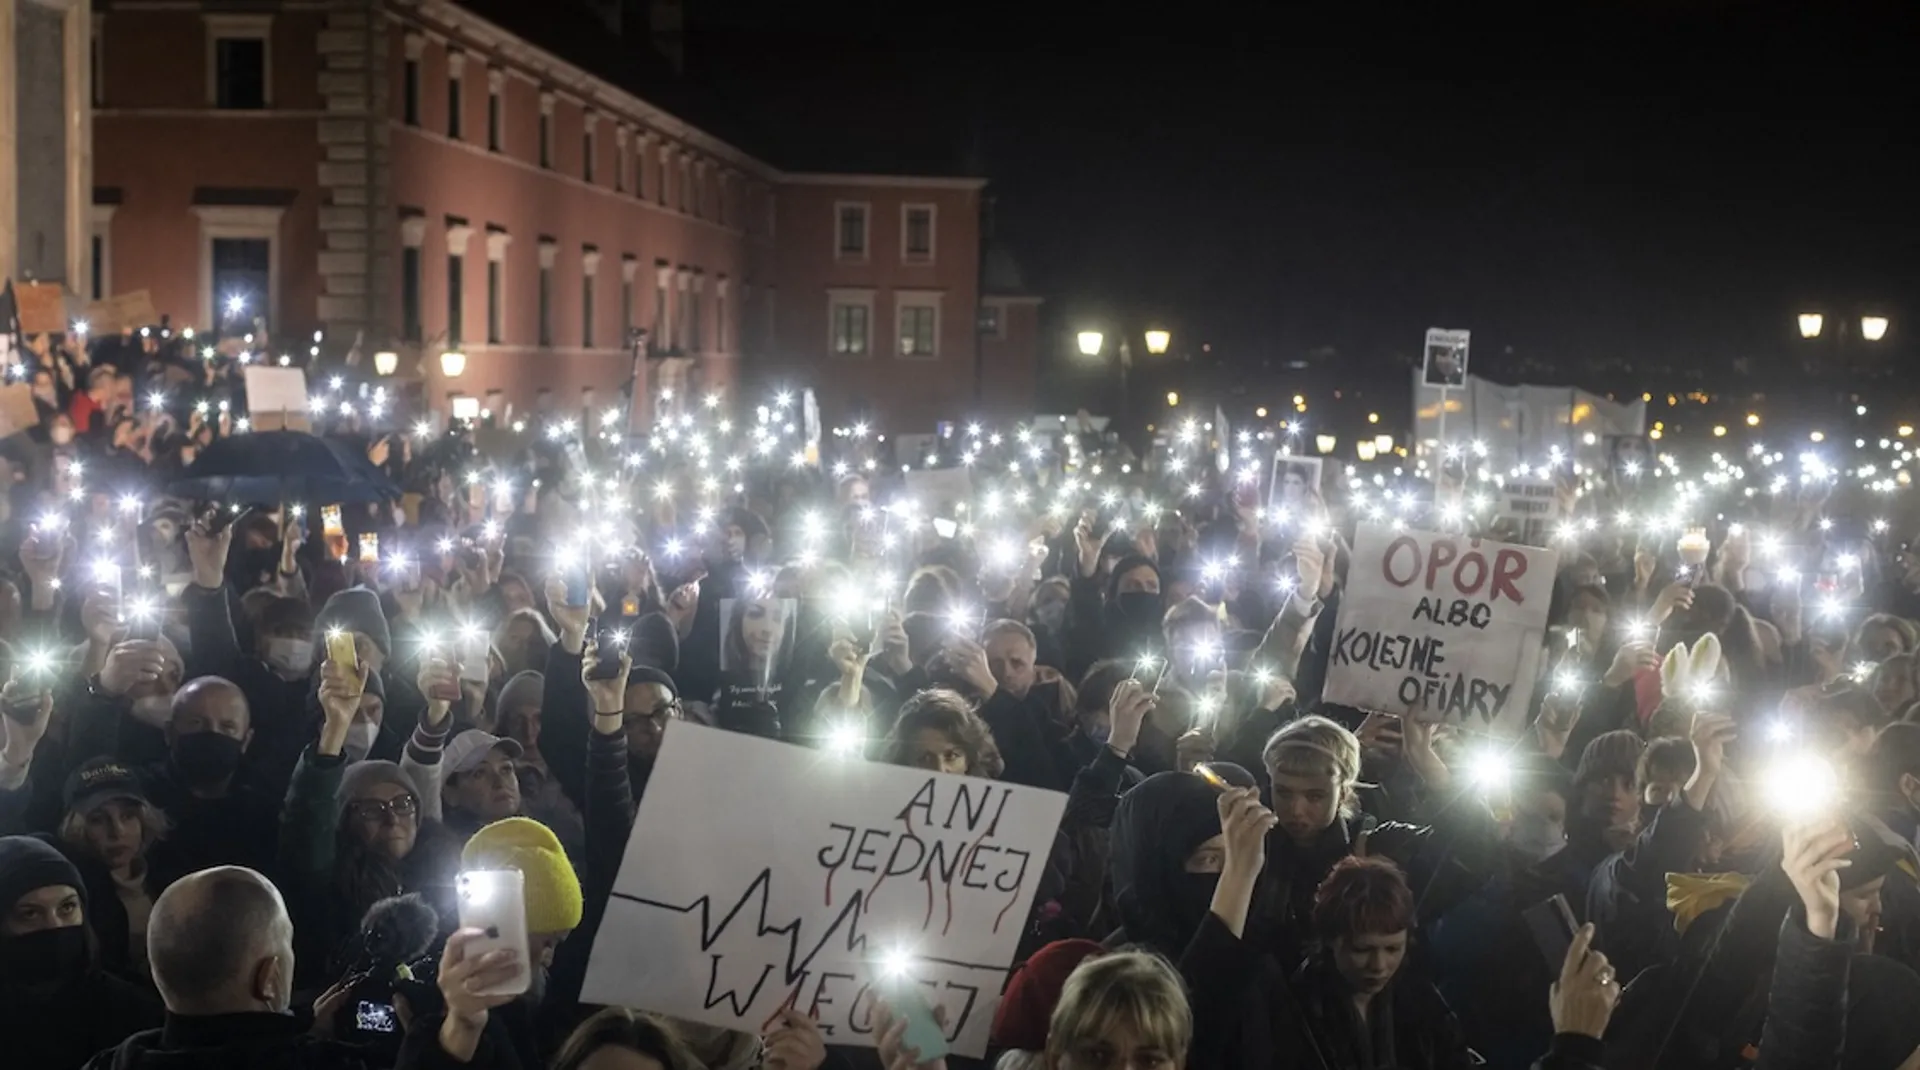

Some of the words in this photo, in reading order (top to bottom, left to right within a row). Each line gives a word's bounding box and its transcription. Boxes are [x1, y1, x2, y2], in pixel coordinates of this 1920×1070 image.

[1383, 537, 1527, 605] OPÓR
[1413, 597, 1492, 629] ALBO
[1333, 628, 1445, 677] KOLEJNE
[896, 778, 1013, 836] ANI
[818, 823, 1030, 892] JEDNEJ
[704, 954, 979, 1043] WIĘCJ
